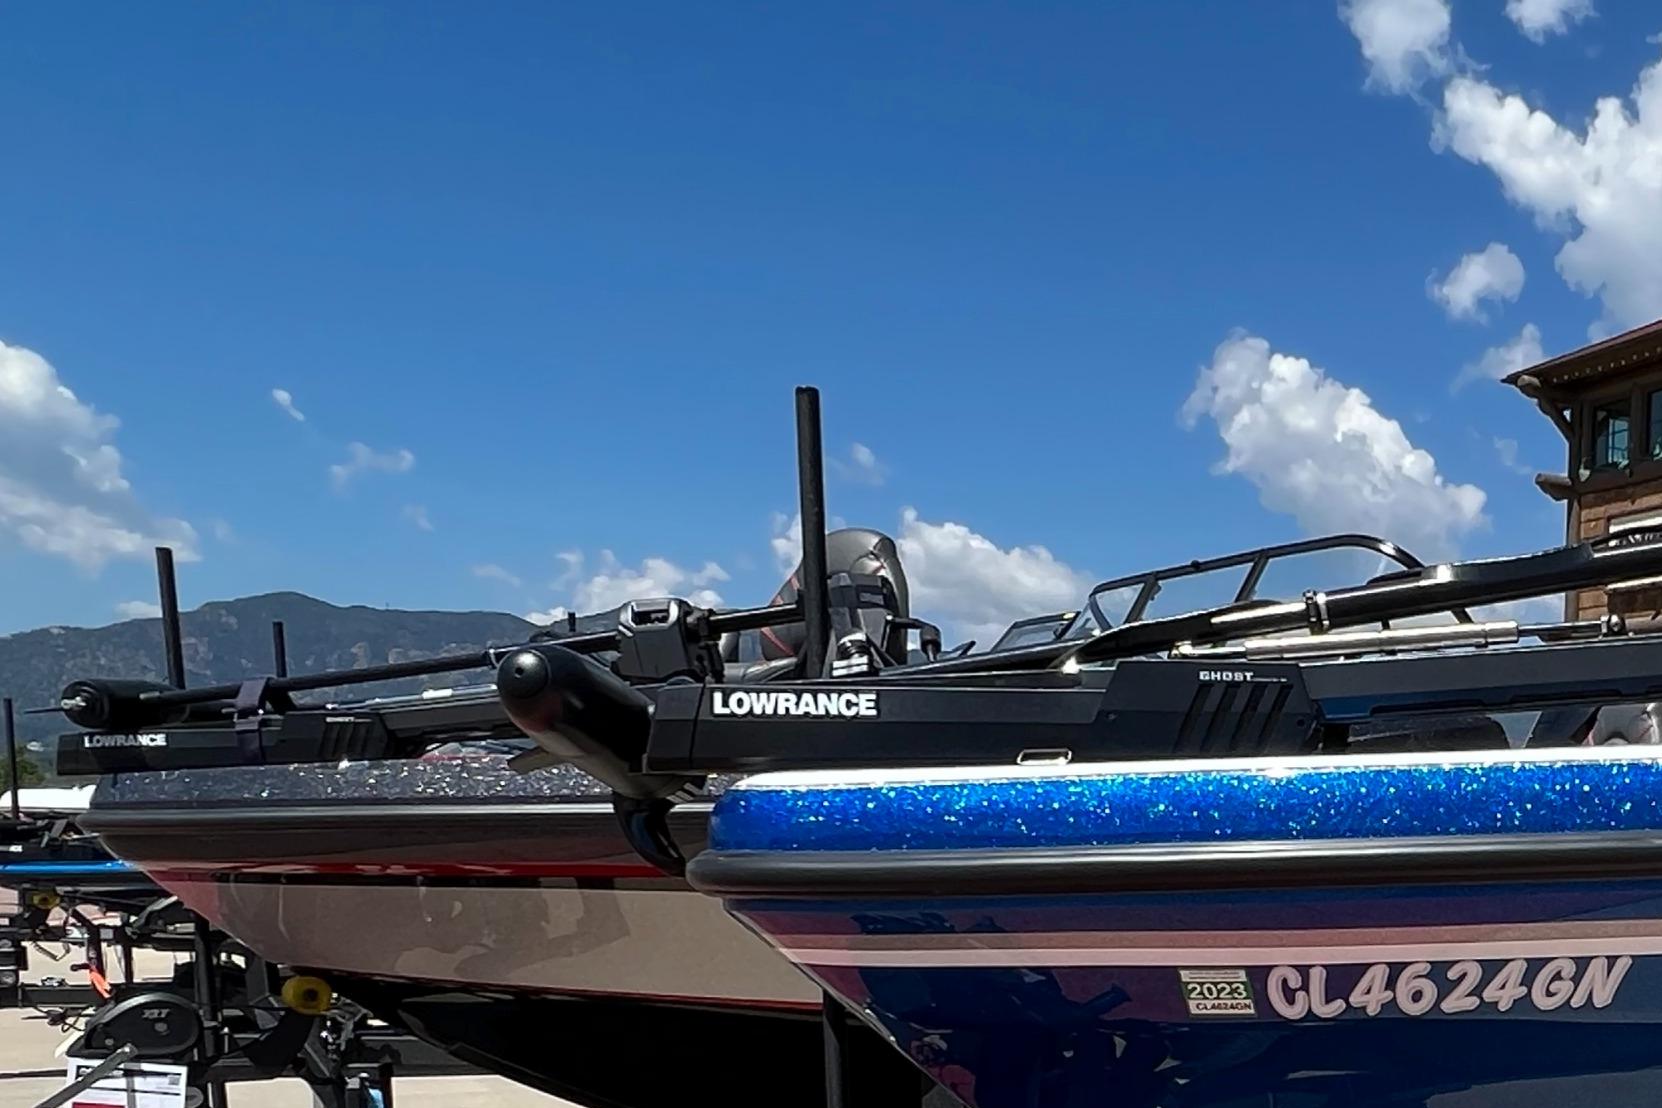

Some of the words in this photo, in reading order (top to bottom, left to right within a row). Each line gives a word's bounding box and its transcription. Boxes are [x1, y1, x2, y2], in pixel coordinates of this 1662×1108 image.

[1199, 671, 1254, 681] GHOST
[712, 691, 878, 717] LOWRANCE
[84, 733, 168, 748] LOWRANCE
[1187, 982, 1247, 999] 2023
[1266, 956, 1634, 1019] CL4624GN
